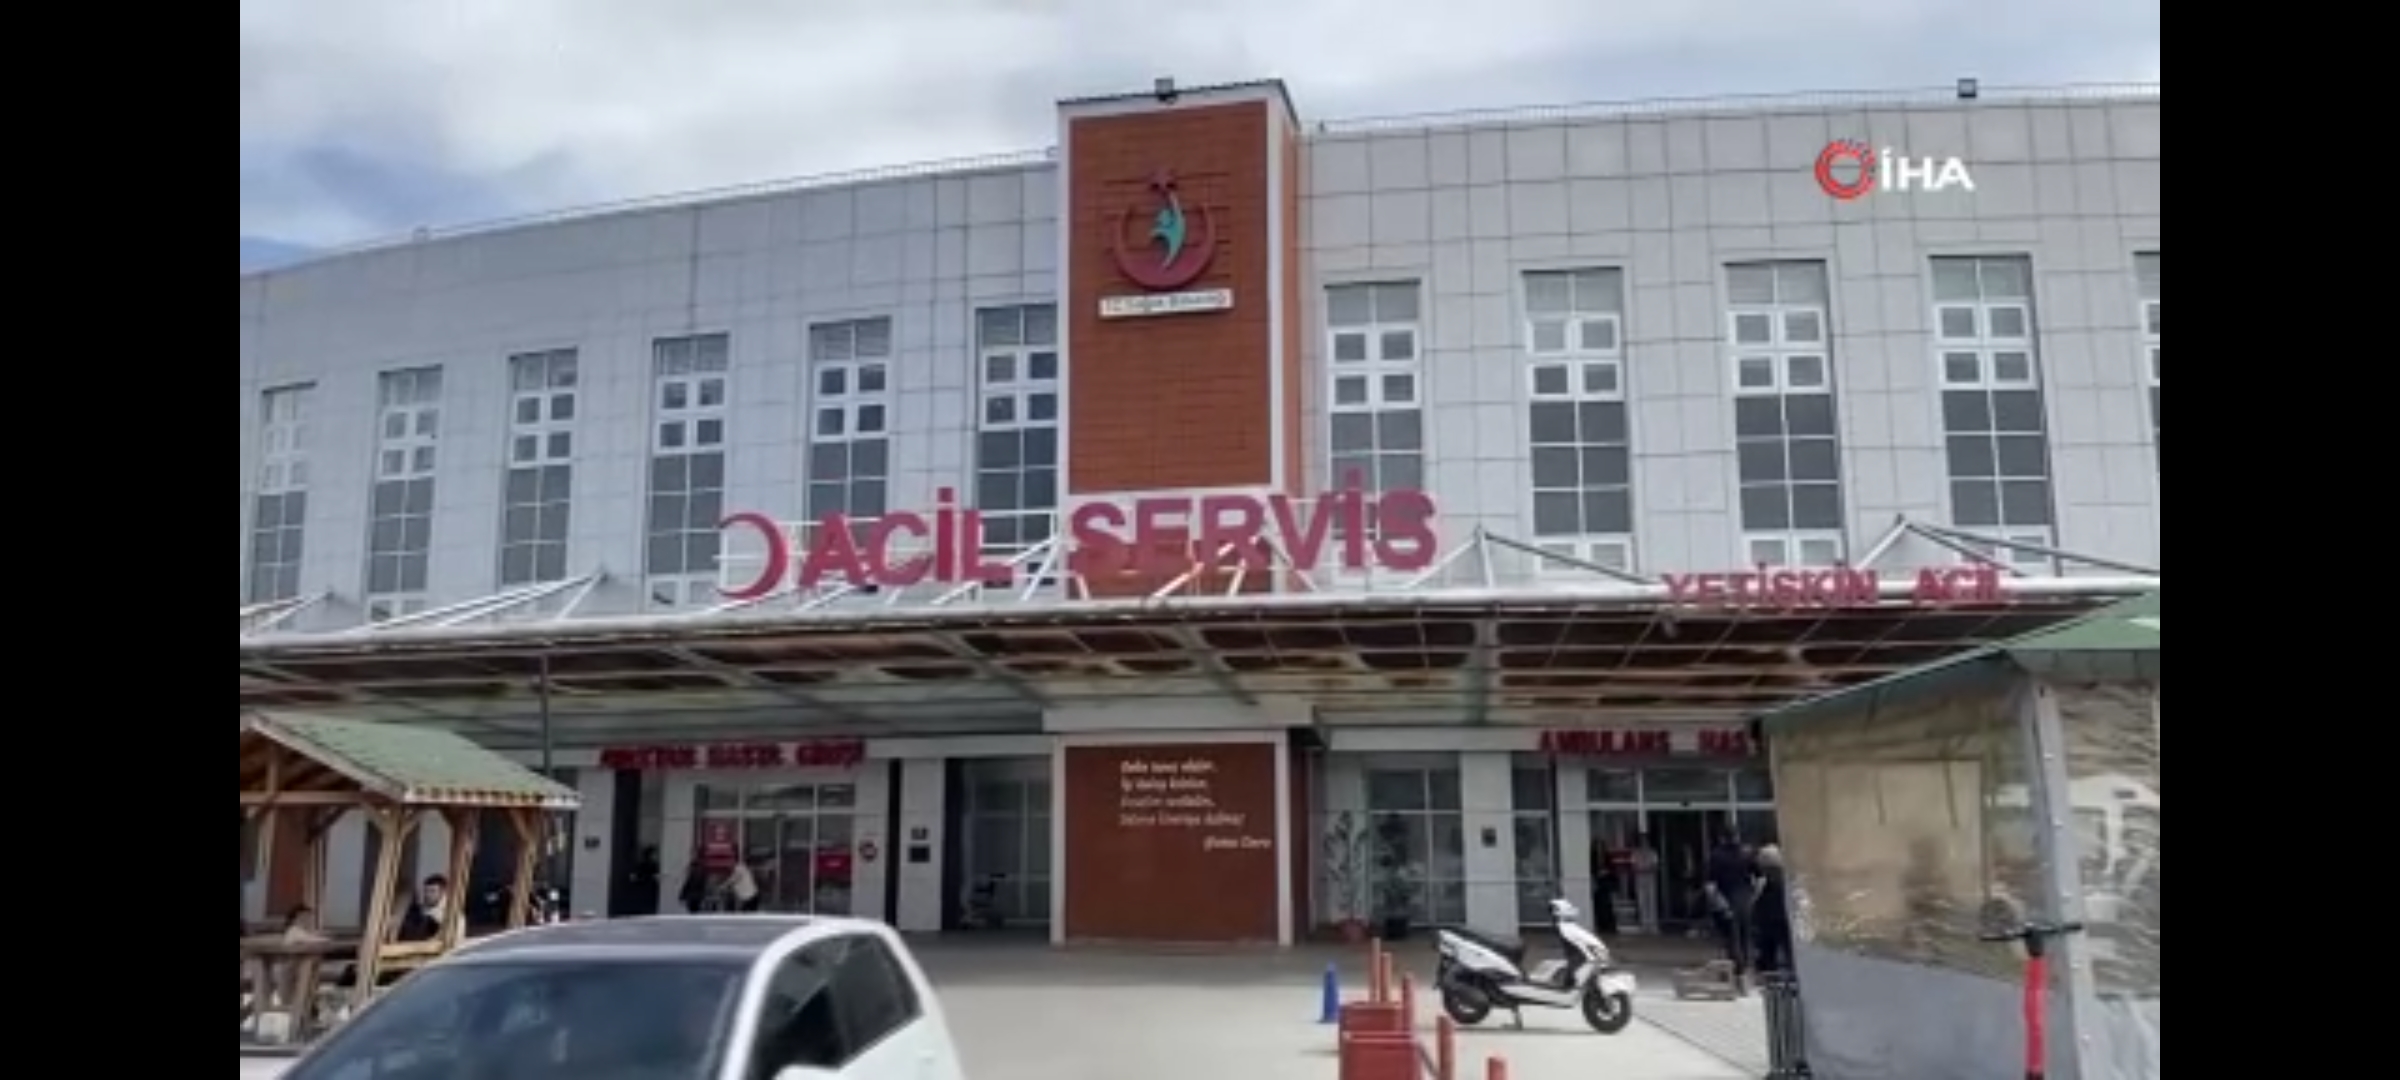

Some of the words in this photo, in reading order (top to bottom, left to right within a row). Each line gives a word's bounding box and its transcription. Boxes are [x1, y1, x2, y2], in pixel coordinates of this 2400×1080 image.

[800, 487, 1012, 587] ACİL
[1068, 469, 1437, 571] SERVİS
[1662, 561, 1879, 605] YETİŞKİN
